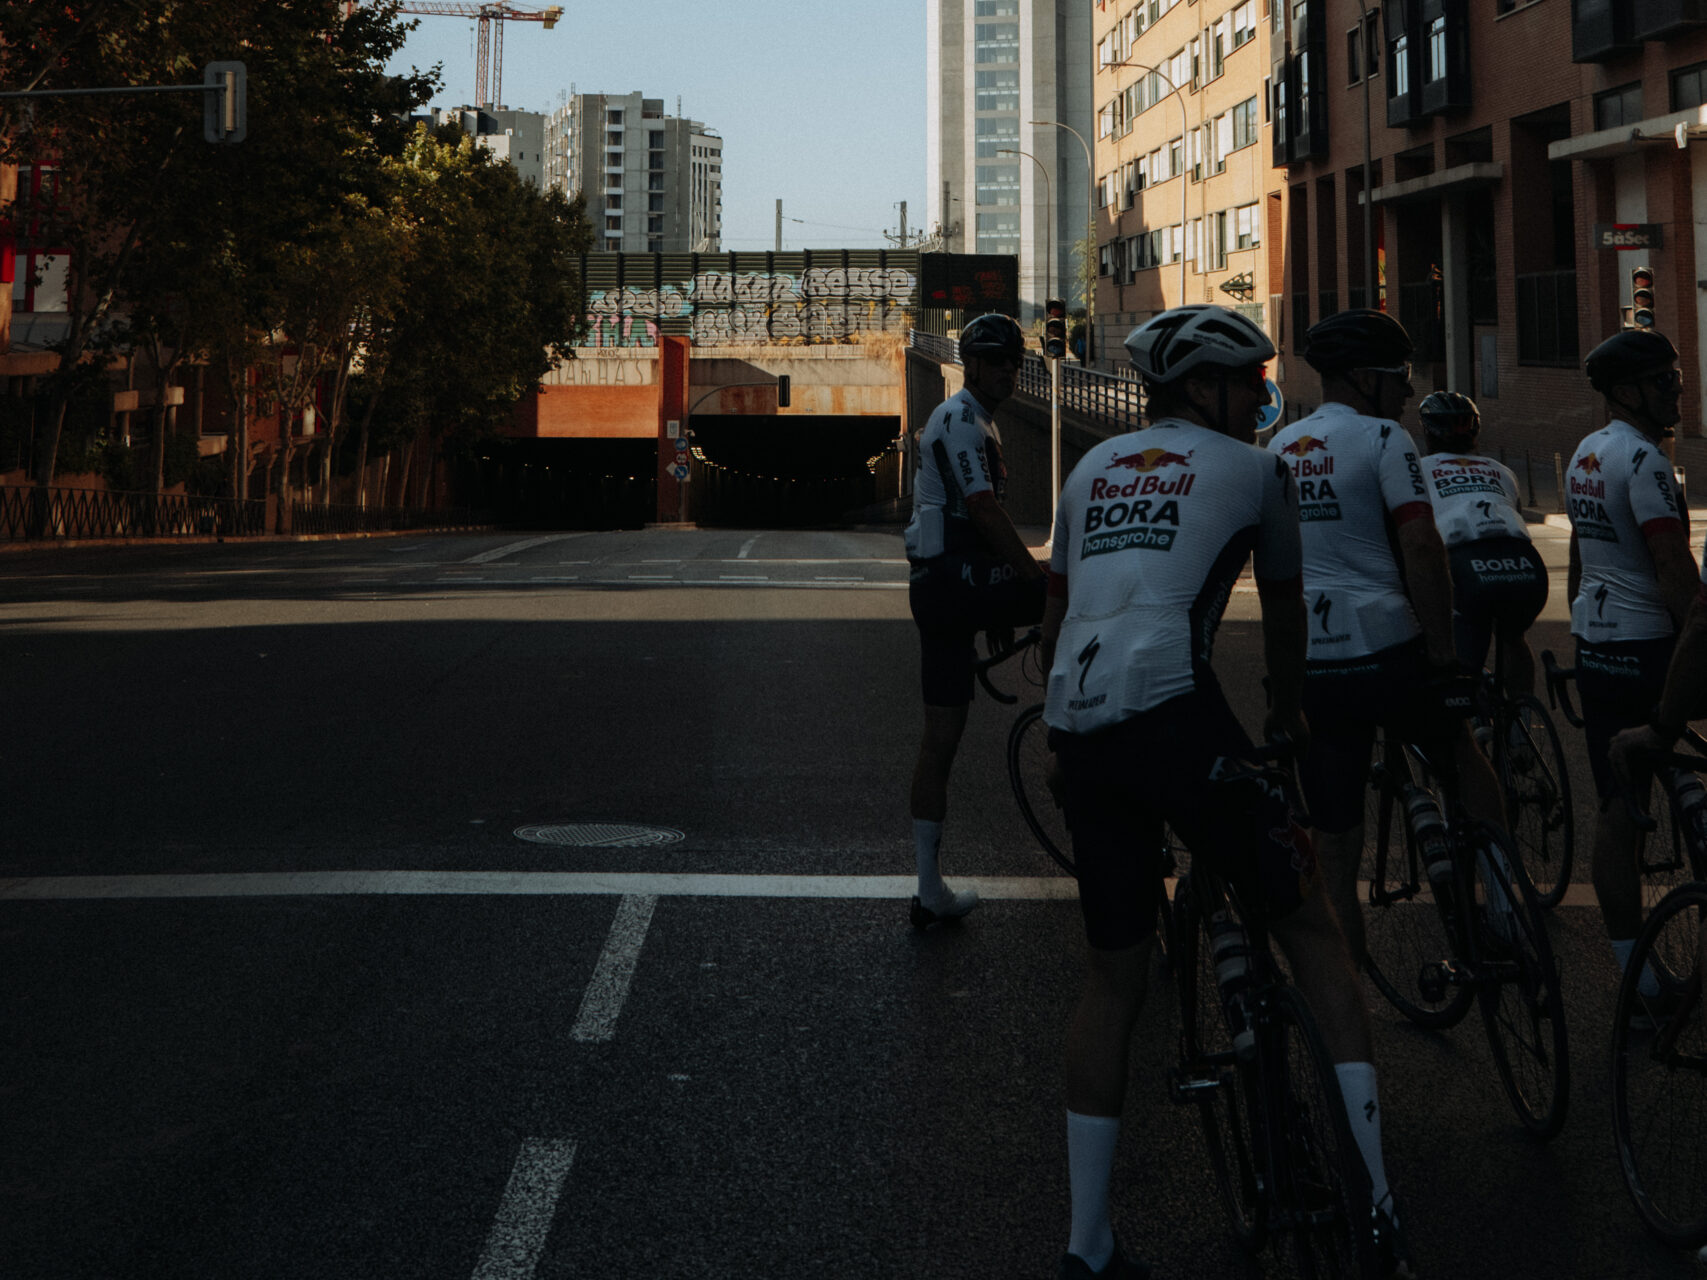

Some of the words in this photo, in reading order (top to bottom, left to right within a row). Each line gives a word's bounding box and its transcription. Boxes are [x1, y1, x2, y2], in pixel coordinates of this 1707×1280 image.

[957, 450, 975, 487] BORA
[1302, 456, 1334, 477] Bull
[1404, 452, 1426, 496] BORA
[1432, 467, 1467, 480] Red
[1468, 468, 1502, 480] Bull
[1090, 476, 1141, 501] Red
[1140, 473, 1196, 496] Bull
[1300, 479, 1337, 501] RA
[1435, 475, 1505, 490] BORA
[1570, 476, 1588, 496] Red
[1588, 479, 1605, 499] Bull
[1084, 499, 1180, 534] BORA
[1572, 498, 1613, 524] BORA
[1083, 530, 1171, 554] hansgrohe
[1471, 556, 1535, 573] BORA
